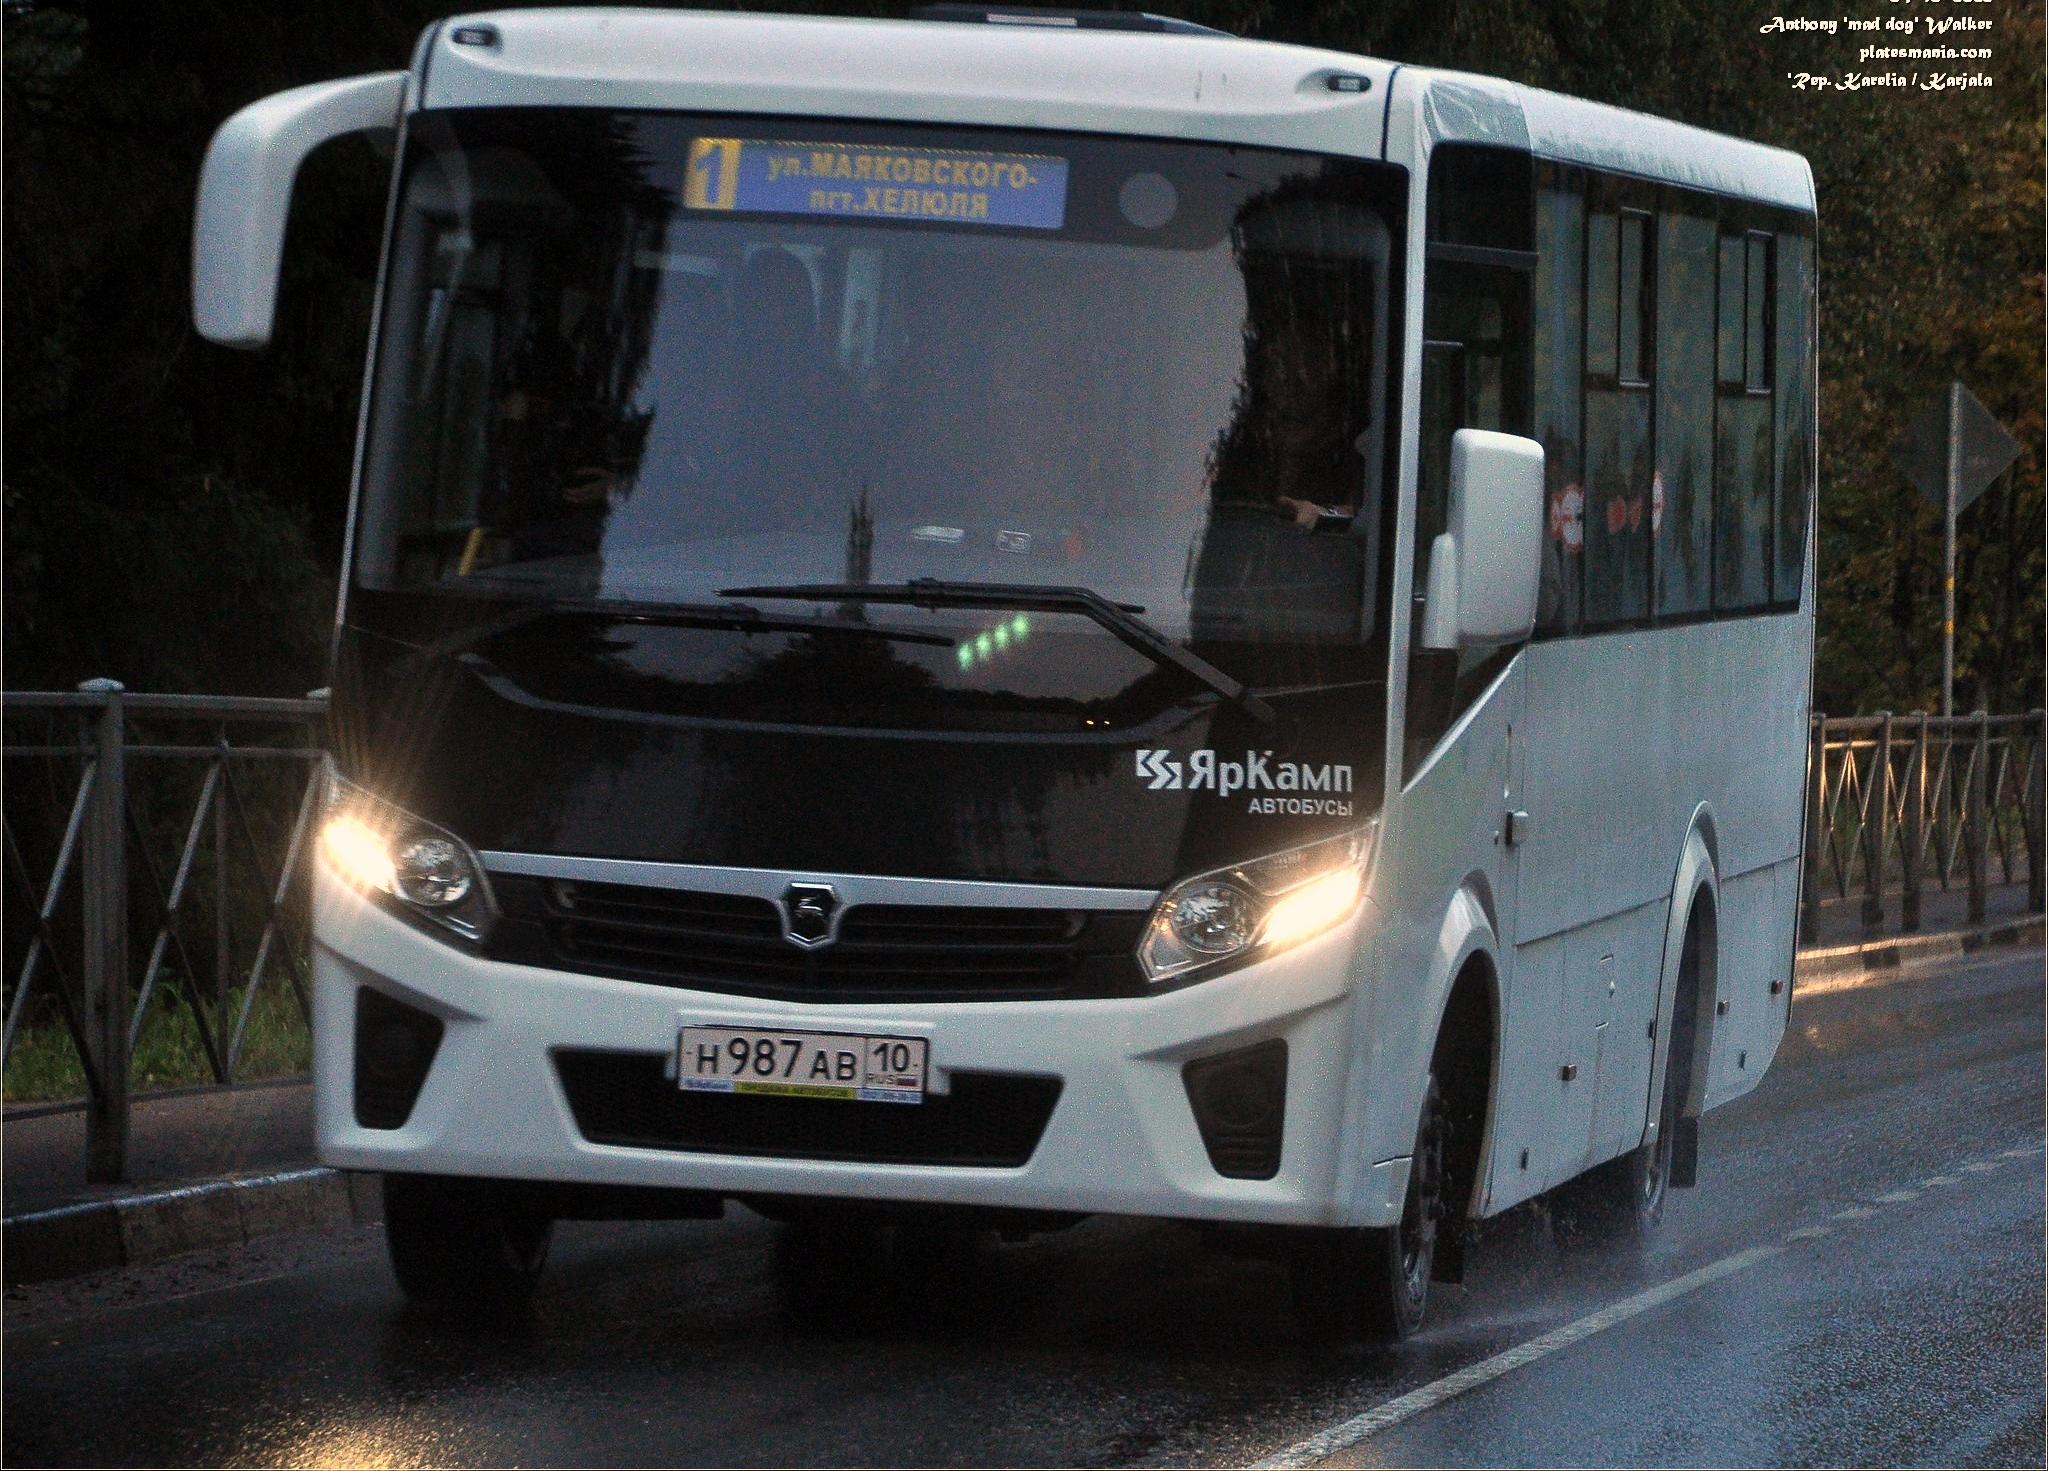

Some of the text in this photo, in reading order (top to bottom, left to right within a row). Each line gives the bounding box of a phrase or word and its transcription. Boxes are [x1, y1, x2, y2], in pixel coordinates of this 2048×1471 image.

[695, 142, 723, 204] 1
[1187, 749, 1353, 797] ЯрКамп
[1248, 798, 1353, 817] АВТОБУСЫ
[872, 1042, 909, 1072] 10
